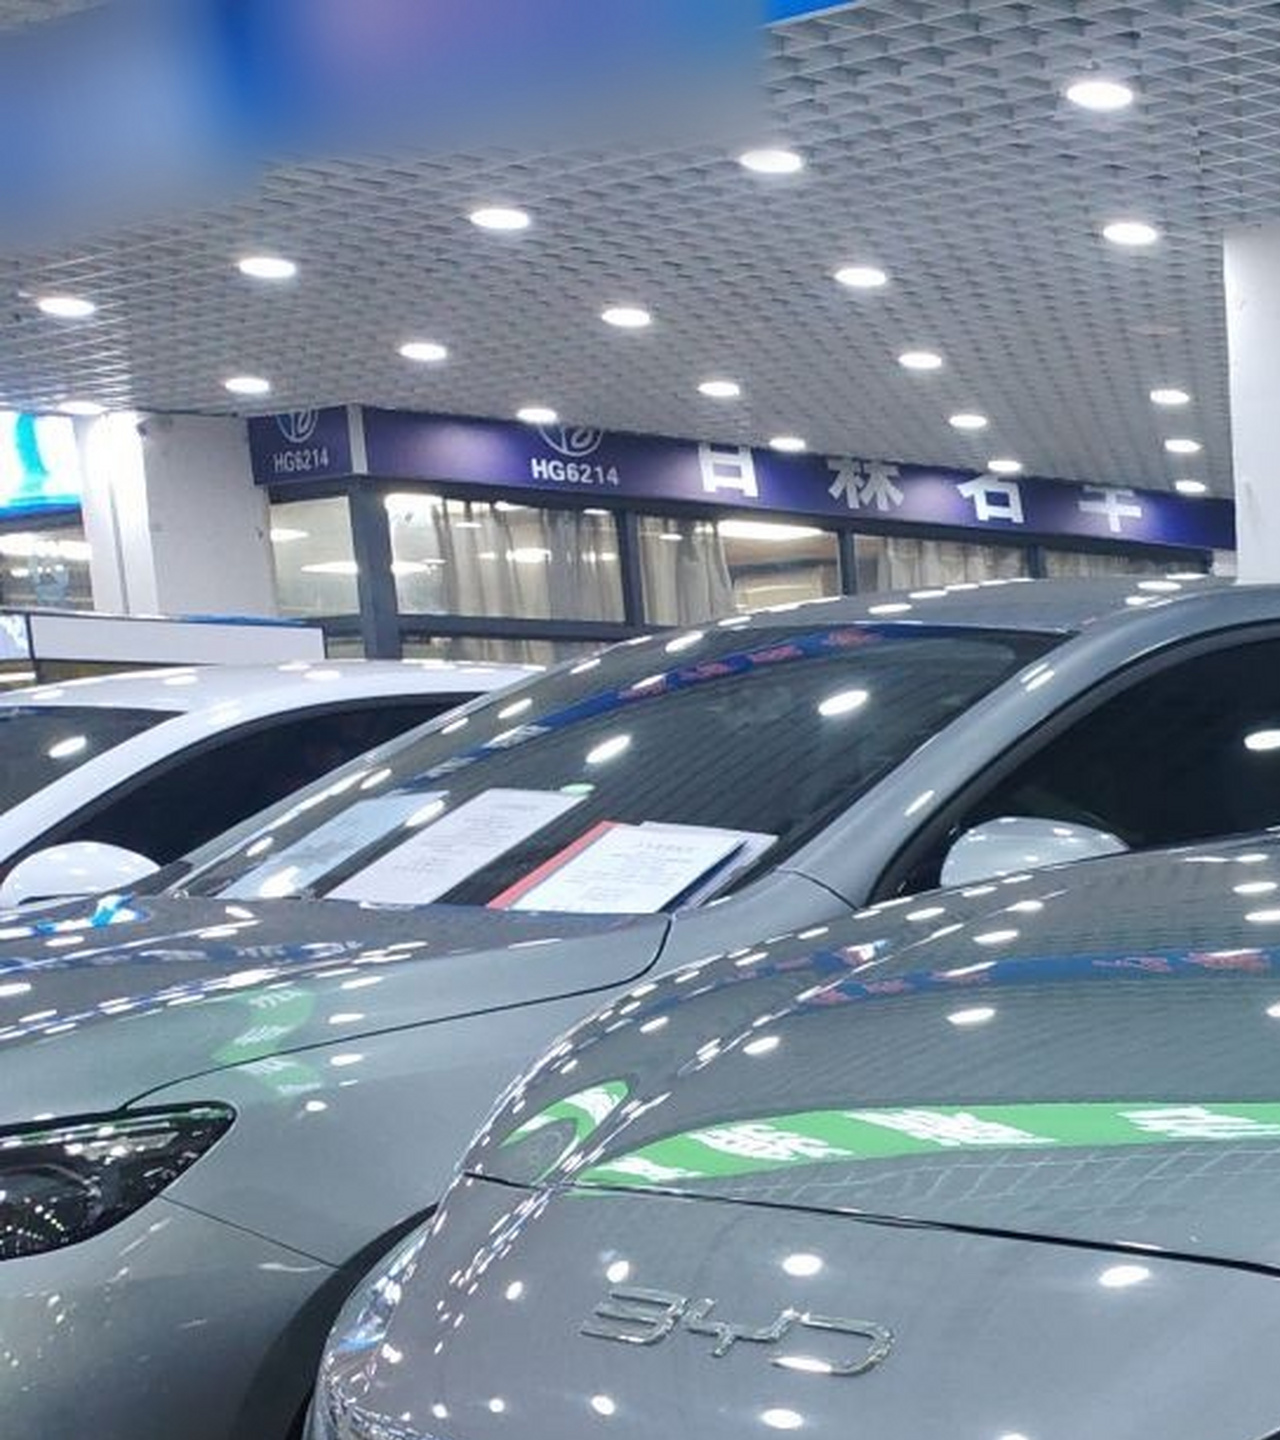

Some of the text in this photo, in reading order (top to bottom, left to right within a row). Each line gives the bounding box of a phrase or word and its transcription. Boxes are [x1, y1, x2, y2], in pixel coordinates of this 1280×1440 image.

[273, 446, 330, 473] HG6214
[531, 457, 621, 487] HG6214
[579, 1285, 896, 1377] BYD
